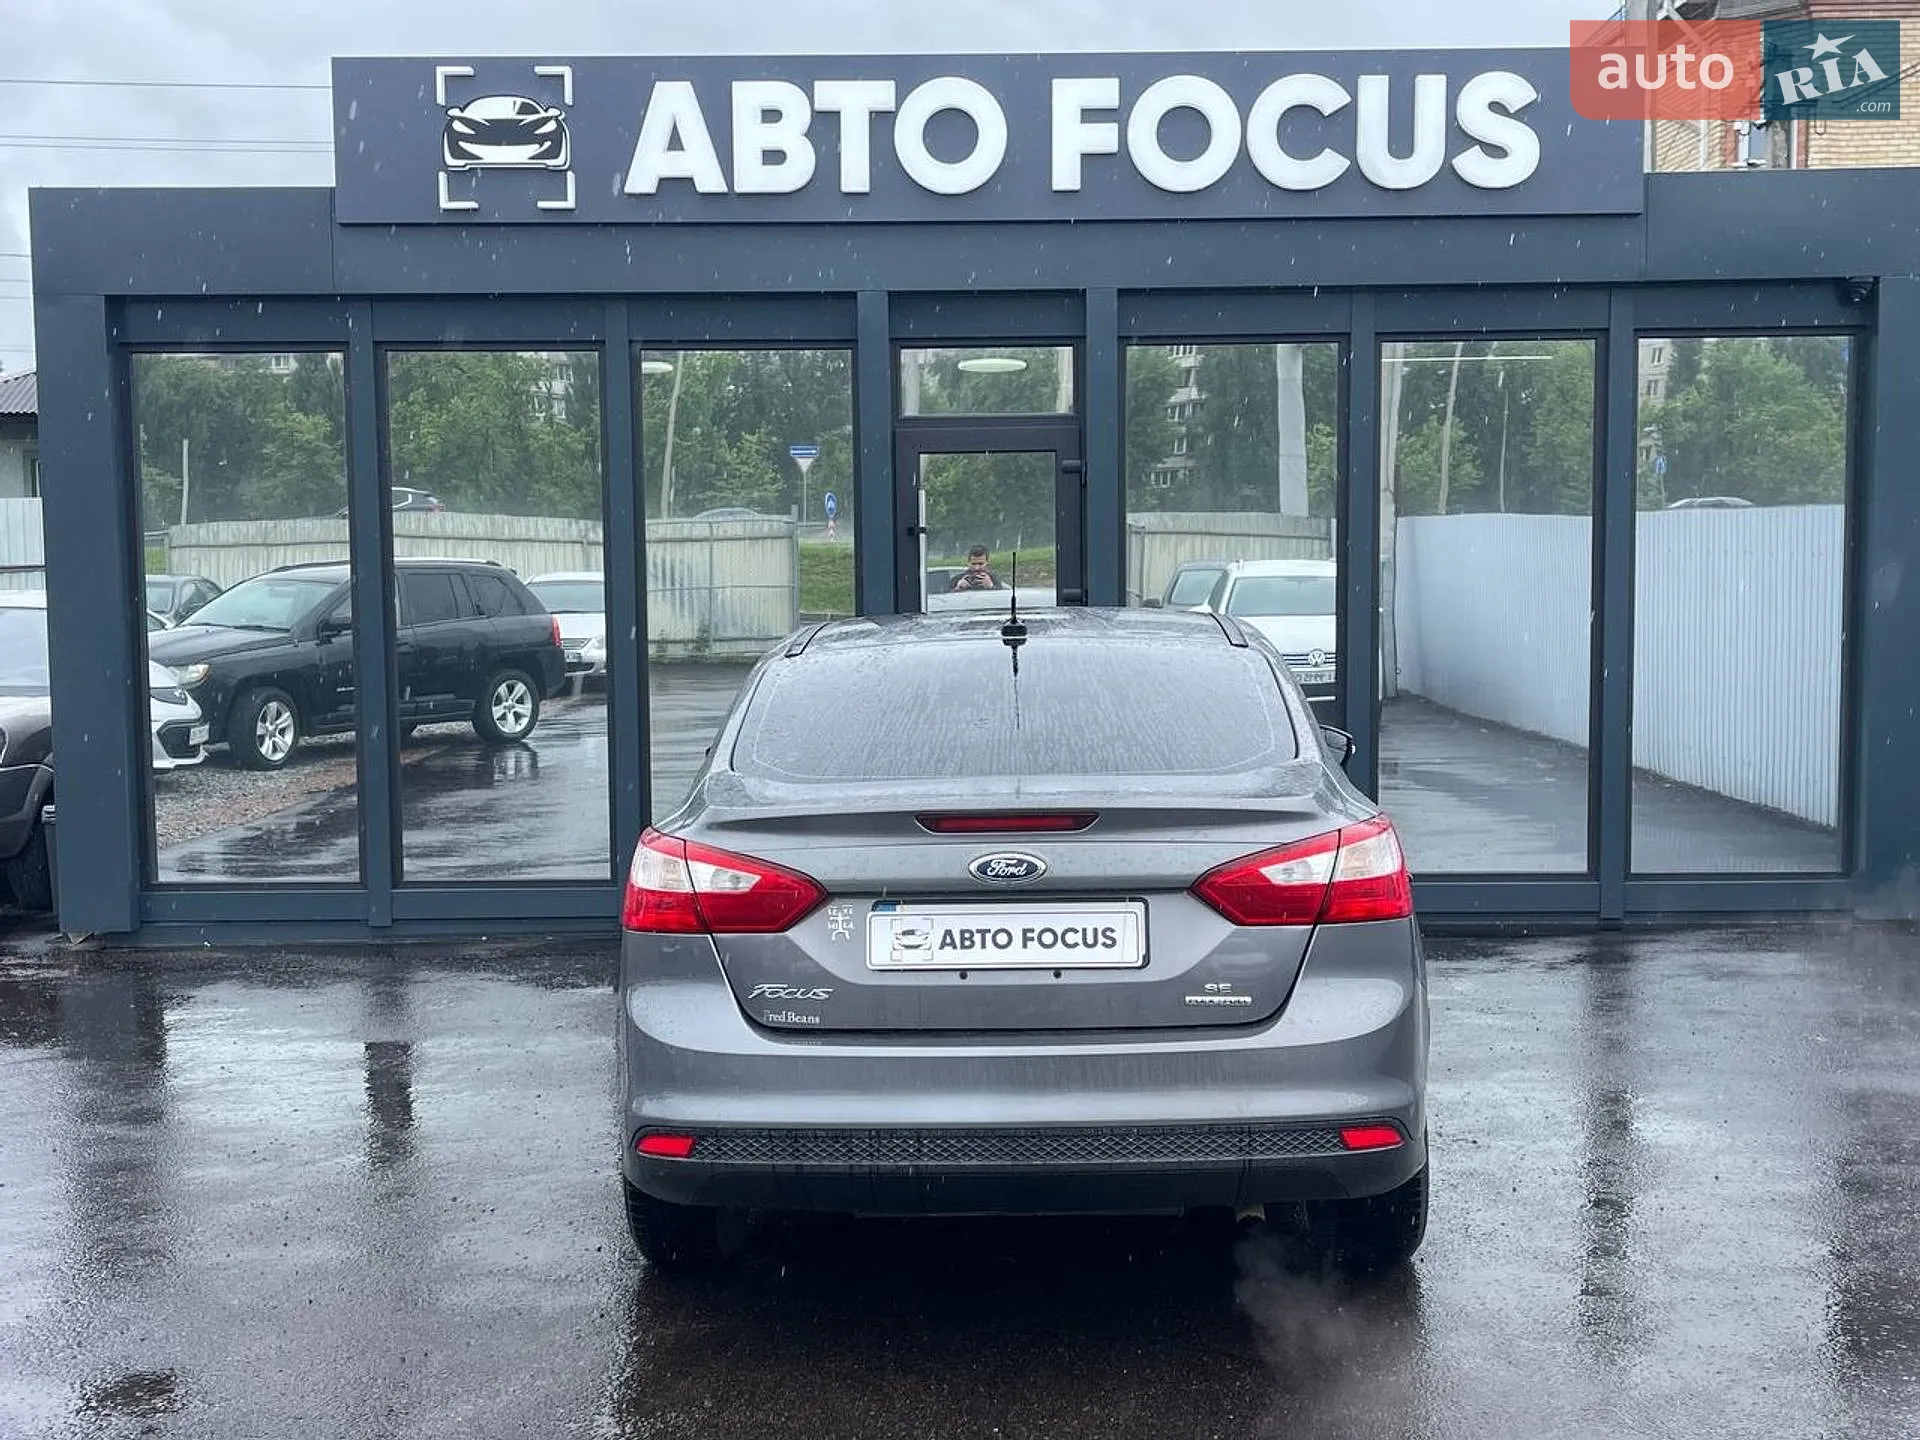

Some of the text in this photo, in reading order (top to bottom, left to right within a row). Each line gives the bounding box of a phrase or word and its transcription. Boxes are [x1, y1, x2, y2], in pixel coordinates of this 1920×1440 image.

[623, 70, 1542, 196] АВТО FOCUS
[986, 858, 1028, 877] Ford
[938, 926, 1118, 951] АВТО FOCUS
[1204, 983, 1232, 993] SE
